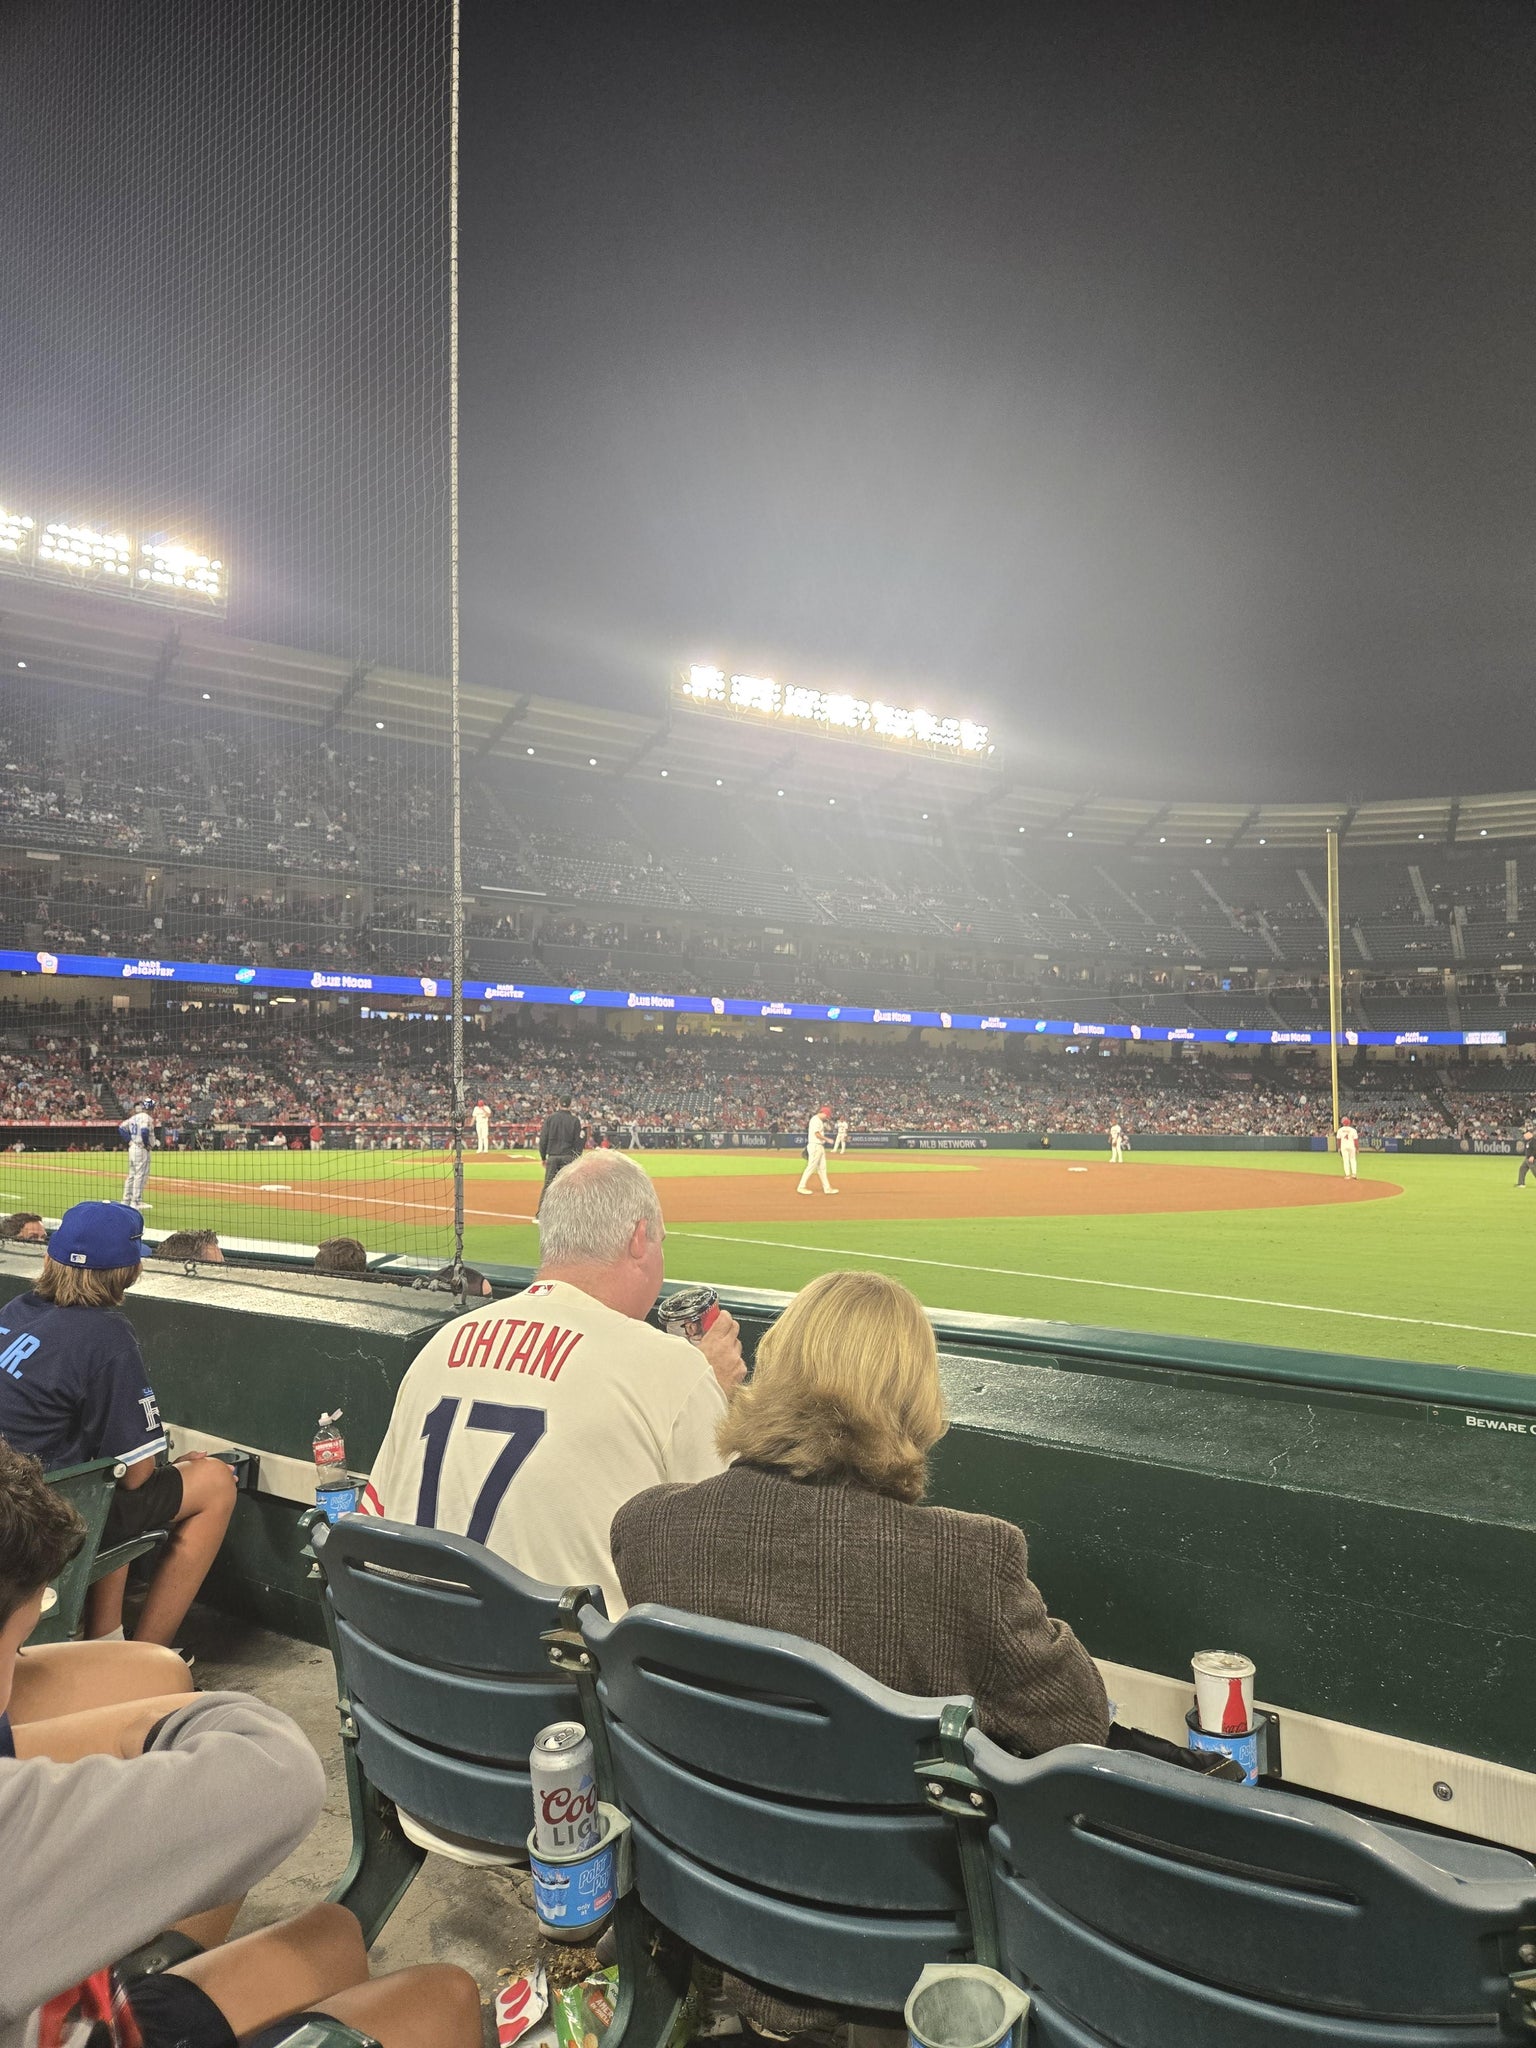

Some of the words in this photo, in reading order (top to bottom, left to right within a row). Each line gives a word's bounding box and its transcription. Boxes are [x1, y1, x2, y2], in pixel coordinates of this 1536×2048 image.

[122, 965, 175, 977] BRIGHTER
[311, 972, 341, 988] BLUE
[342, 976, 373, 989] MOON
[627, 993, 651, 1008] BLUE
[651, 998, 675, 1008] MOON
[742, 1135, 766, 1145] Modelo
[919, 1140, 936, 1148] MLB
[937, 1140, 976, 1148] NETWORK
[1474, 1140, 1511, 1153] Modelo
[447, 1318, 584, 1382] OHTANI
[416, 1395, 548, 1547] 17
